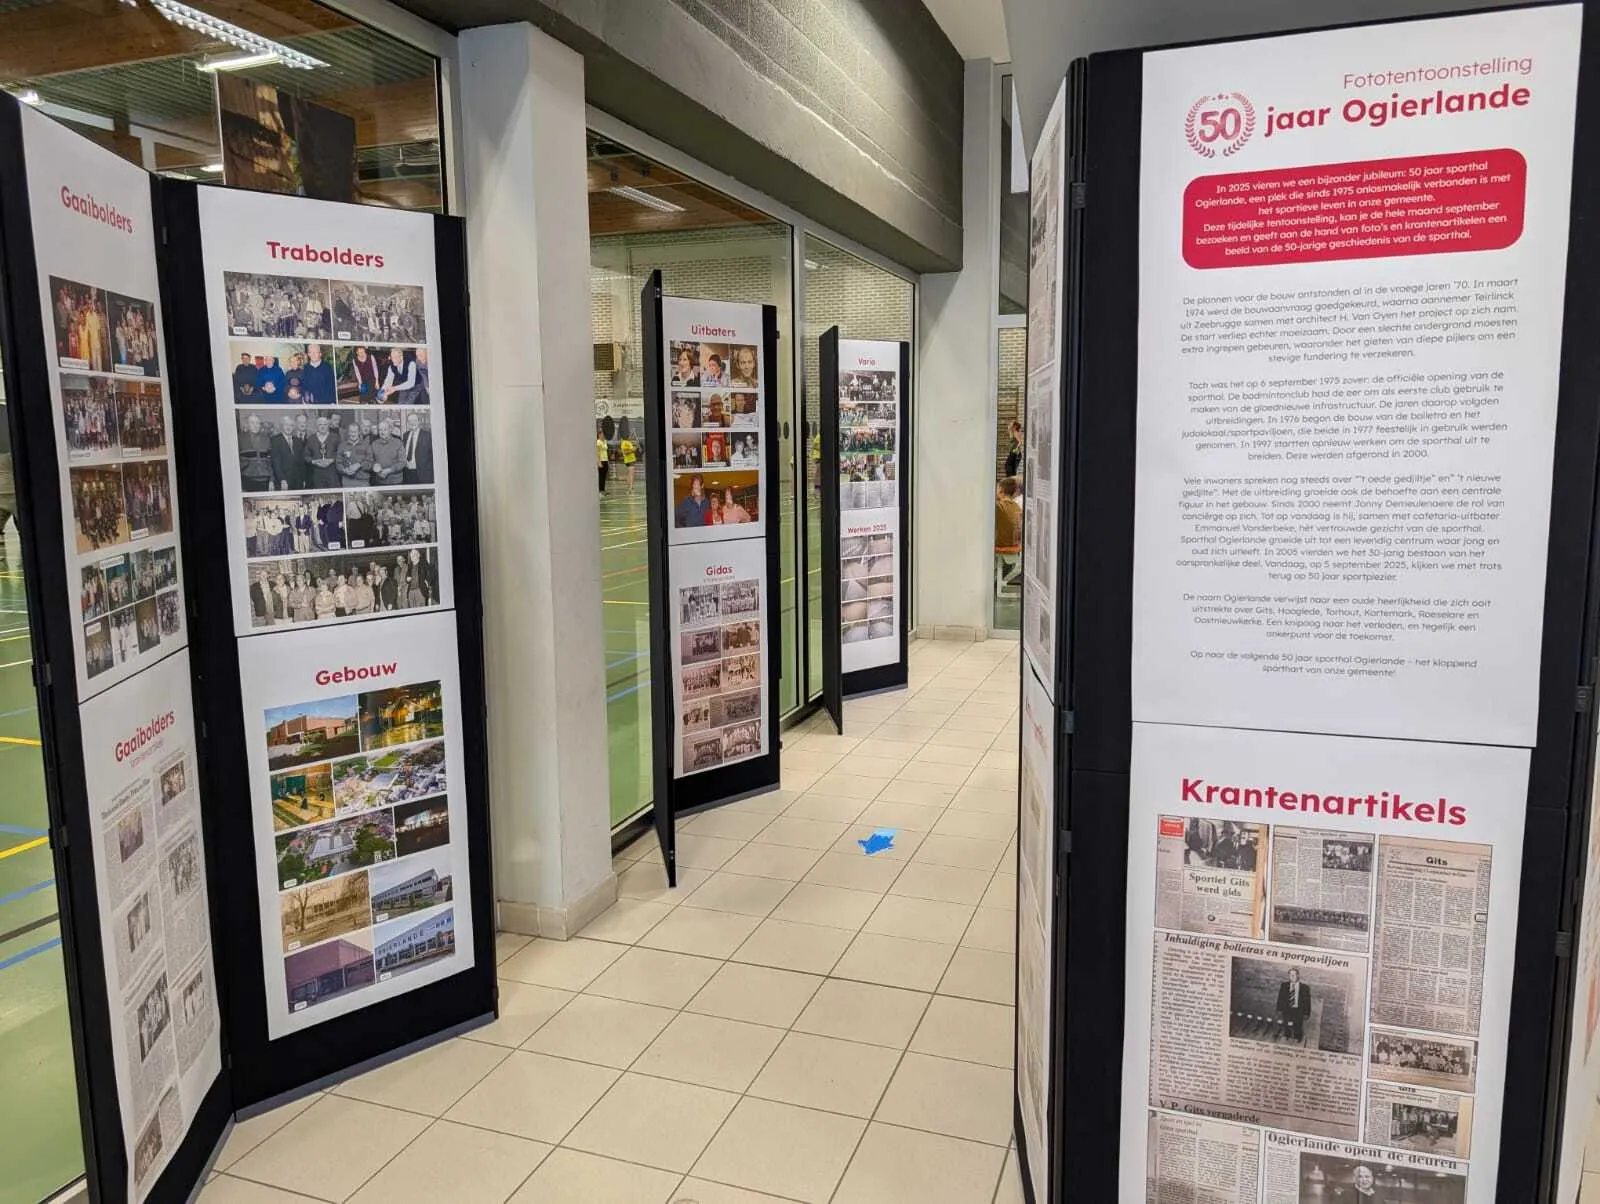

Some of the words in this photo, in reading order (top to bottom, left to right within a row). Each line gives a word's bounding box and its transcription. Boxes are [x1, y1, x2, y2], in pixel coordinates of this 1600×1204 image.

[1343, 56, 1533, 89] Fototentoonstelling
[1199, 108, 1242, 142] 50
[1265, 105, 1331, 137] jaar
[1342, 83, 1531, 127] Ogierlande
[1195, 194, 1246, 209] Ogierlande,
[1248, 194, 1265, 202] een
[1267, 191, 1286, 203] plek
[1288, 189, 1303, 199] die
[1306, 187, 1330, 198] sinds
[1333, 185, 1353, 196] 1975
[1356, 180, 1420, 196] onlosmakelijk
[1424, 176, 1477, 189] verbonden
[1480, 175, 1487, 184] is
[1490, 173, 1510, 184] met
[1216, 183, 1226, 193] In
[1228, 181, 1250, 192] 2025
[1252, 179, 1279, 190] vieren
[1282, 179, 1295, 187] we
[1297, 177, 1315, 186] een
[1317, 172, 1360, 187] bijzonder
[1363, 168, 1405, 183] jubileum:
[1409, 167, 1421, 176] 50
[1423, 165, 1443, 178] jaar
[1446, 161, 1487, 176] sporthal
[60, 185, 133, 234] Gaaibolders
[1204, 221, 1225, 231] Deze
[1227, 218, 1264, 232] tijdelijke
[1267, 213, 1336, 229] tentoonstelling,
[1339, 211, 1357, 221] kan
[1359, 210, 1368, 222] je
[1370, 209, 1382, 219] de
[1385, 208, 1405, 218] hele
[1407, 205, 1442, 216] maand
[1445, 201, 1499, 216] september
[1258, 205, 1272, 215] het
[1275, 202, 1318, 216] sportieve
[1320, 200, 1345, 210] leven
[1347, 199, 1356, 208] in
[1358, 199, 1381, 207] onze
[1383, 193, 1434, 208] gemeente.
[1196, 233, 1238, 245] bezoeken
[1253, 230, 1277, 243] geeft
[1280, 230, 1297, 239] aan
[1300, 228, 1312, 237] de
[1314, 226, 1338, 236] hand
[1340, 226, 1358, 234] van
[1361, 222, 1387, 233] foto's
[1390, 223, 1402, 231] en
[1404, 215, 1485, 230] krantenartikelen
[1487, 215, 1506, 224] een
[1225, 244, 1249, 255] beeld
[1251, 245, 1268, 253] van
[1270, 242, 1282, 252] de
[1284, 239, 1326, 253] 50-jarige
[1328, 235, 1390, 250] geschiedenis
[1392, 236, 1410, 244] van
[1413, 233, 1426, 242] de
[1428, 230, 1471, 244] sporthal.
[266, 241, 385, 268] Trabolders
[691, 325, 736, 338] Uitbaters
[706, 565, 733, 576] Gidas
[315, 662, 398, 686] Gebouw
[115, 710, 175, 762] Gaaibolders
[1181, 778, 1467, 826] Krantenartikels
[1426, 856, 1449, 866] Gits
[1189, 872, 1226, 885] Sportief
[1230, 877, 1250, 887] Gits
[1196, 885, 1220, 894] werd
[1164, 933, 1221, 952] Inhuldiging
[1222, 939, 1265, 955] bolletras
[1266, 947, 1279, 956] en
[1280, 948, 1350, 969] sportpaviljoen
[1267, 1132, 1340, 1156] Ogierlande
[1344, 1144, 1382, 1161] opent
[1387, 1149, 1405, 1162] de
[1408, 1153, 1457, 1171] deuren
